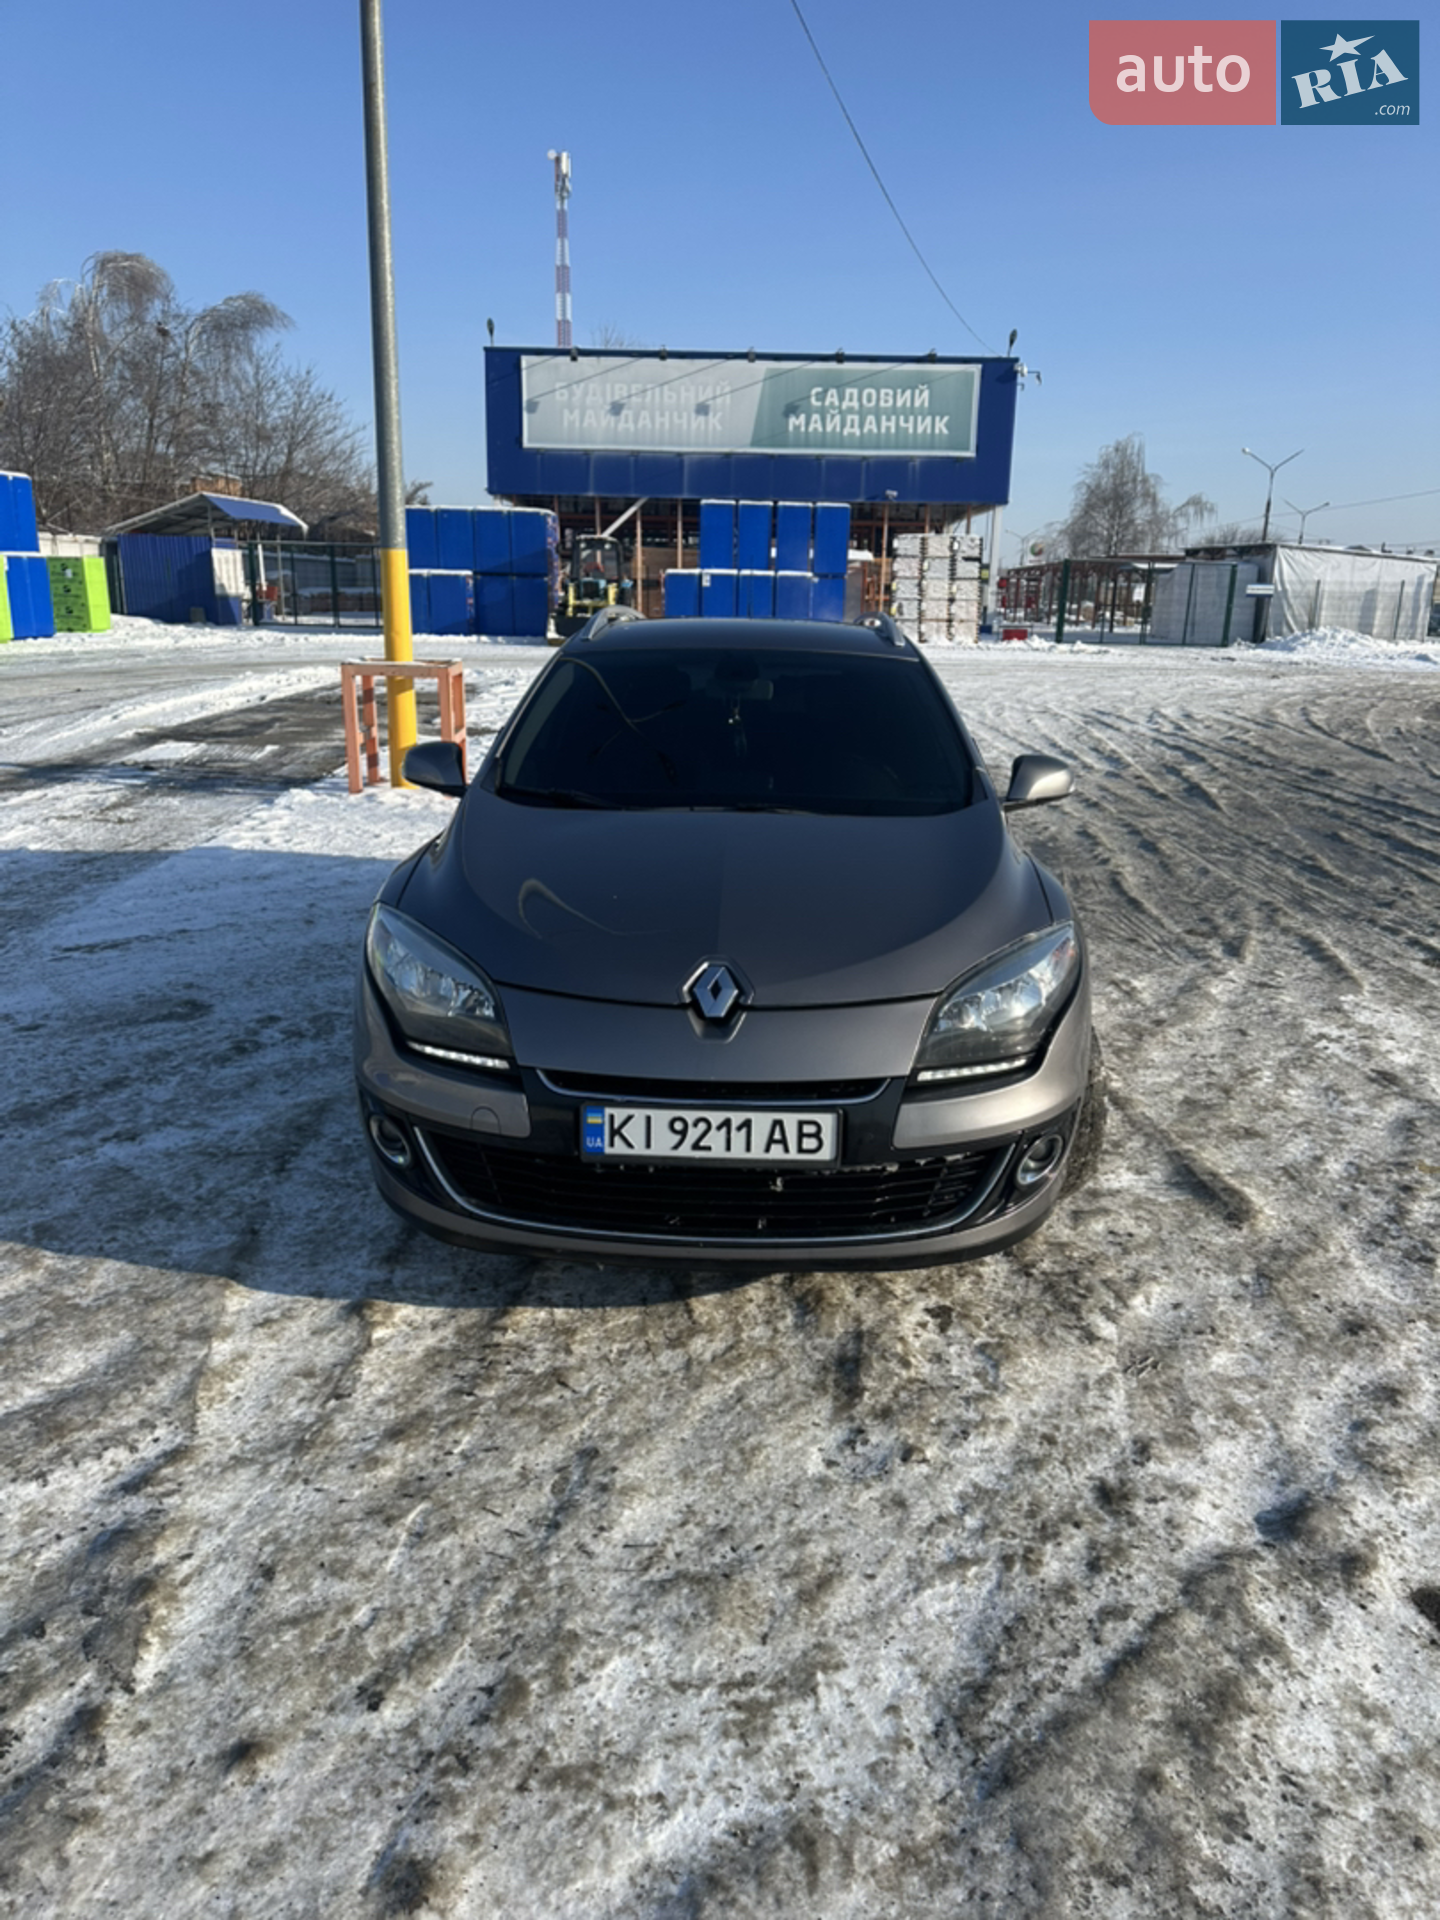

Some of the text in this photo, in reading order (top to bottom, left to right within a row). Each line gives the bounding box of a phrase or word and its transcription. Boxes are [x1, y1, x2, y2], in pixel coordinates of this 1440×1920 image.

[553, 381, 732, 405] БУДІВЕЛЬНИЙ
[810, 383, 930, 410] САДОВИЙ
[562, 405, 724, 432] МАЙДАНЧИК
[788, 408, 950, 436] МАЙДАНЧИК
[586, 1136, 603, 1148] UA
[608, 1113, 825, 1155] KI 9211 AB
